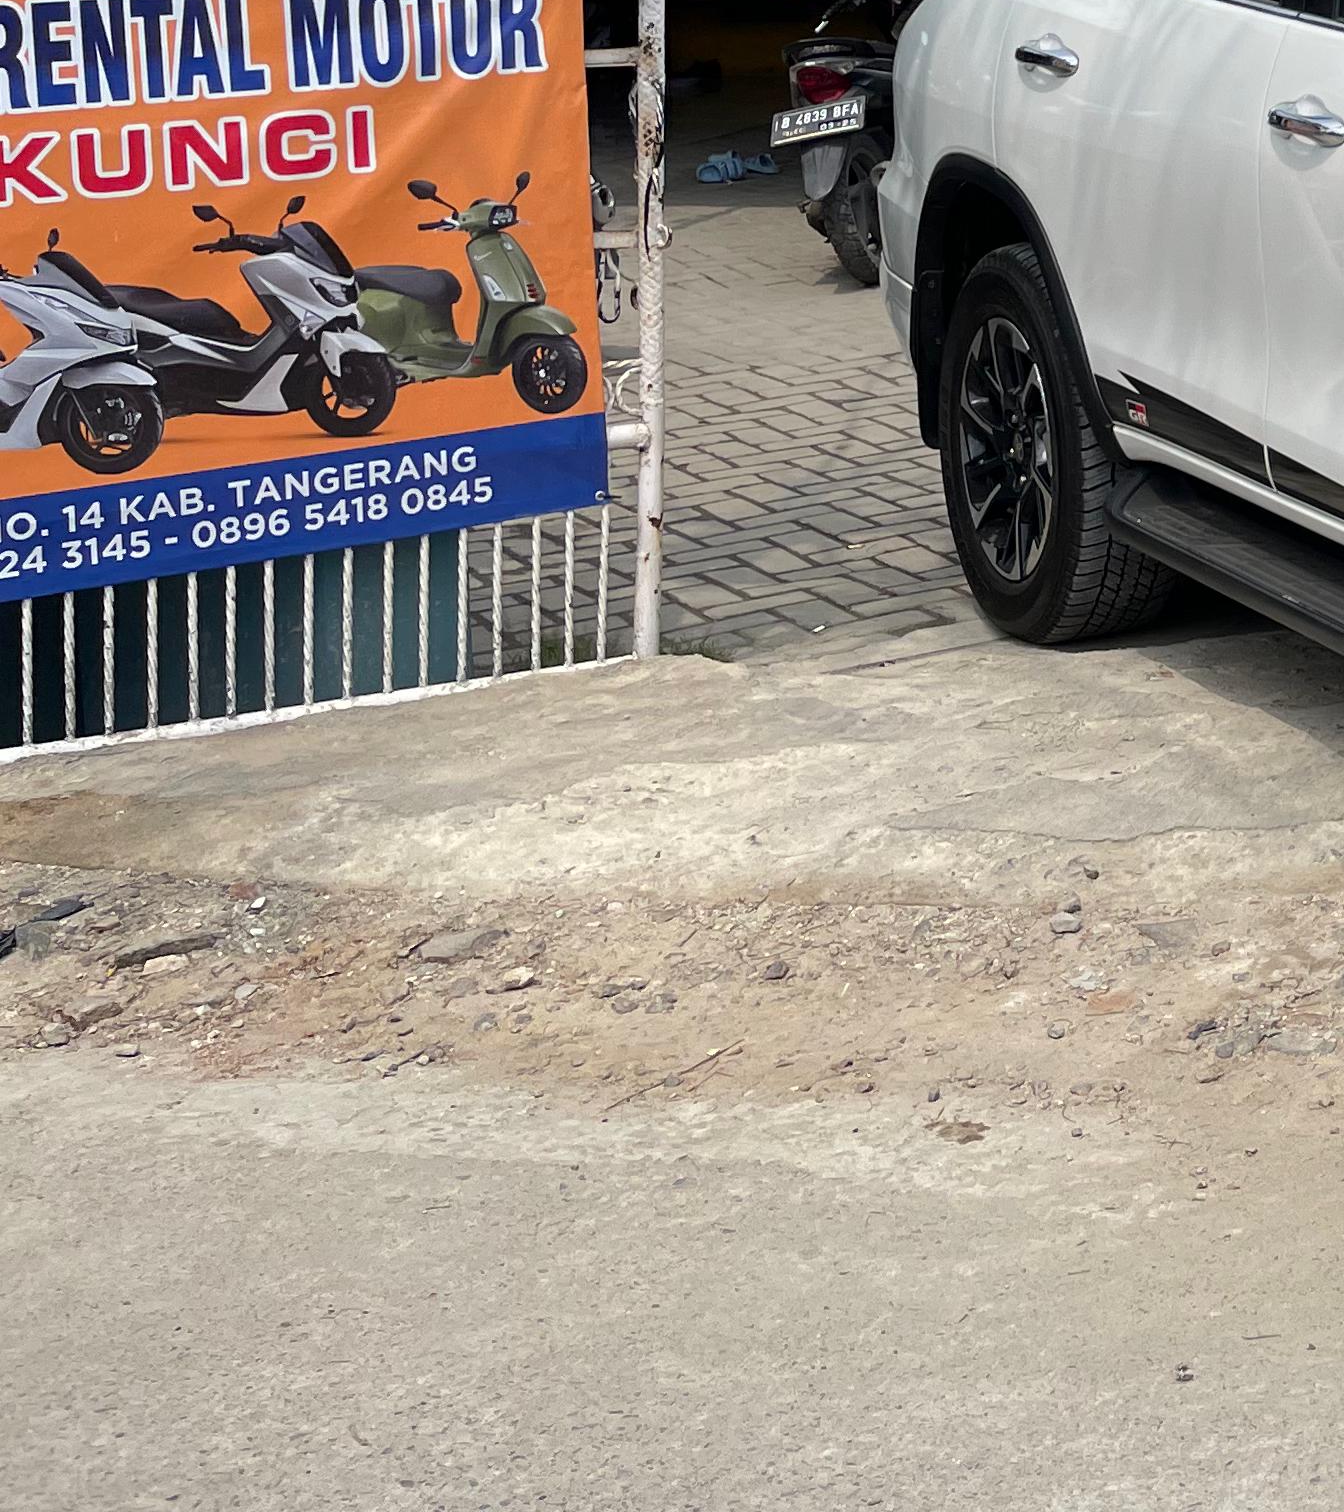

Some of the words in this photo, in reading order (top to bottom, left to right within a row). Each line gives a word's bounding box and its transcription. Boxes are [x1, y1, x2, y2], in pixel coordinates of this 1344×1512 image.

[0, 111, 370, 202] KUNCI
[0, 512, 49, 544] O.
[62, 501, 105, 533] 14
[119, 487, 215, 526] KAB.
[227, 445, 478, 508] TANGERANG
[61, 530, 151, 569] 3145
[191, 508, 291, 548] 0896
[303, 493, 388, 531] 5418
[399, 475, 494, 515] 0845
